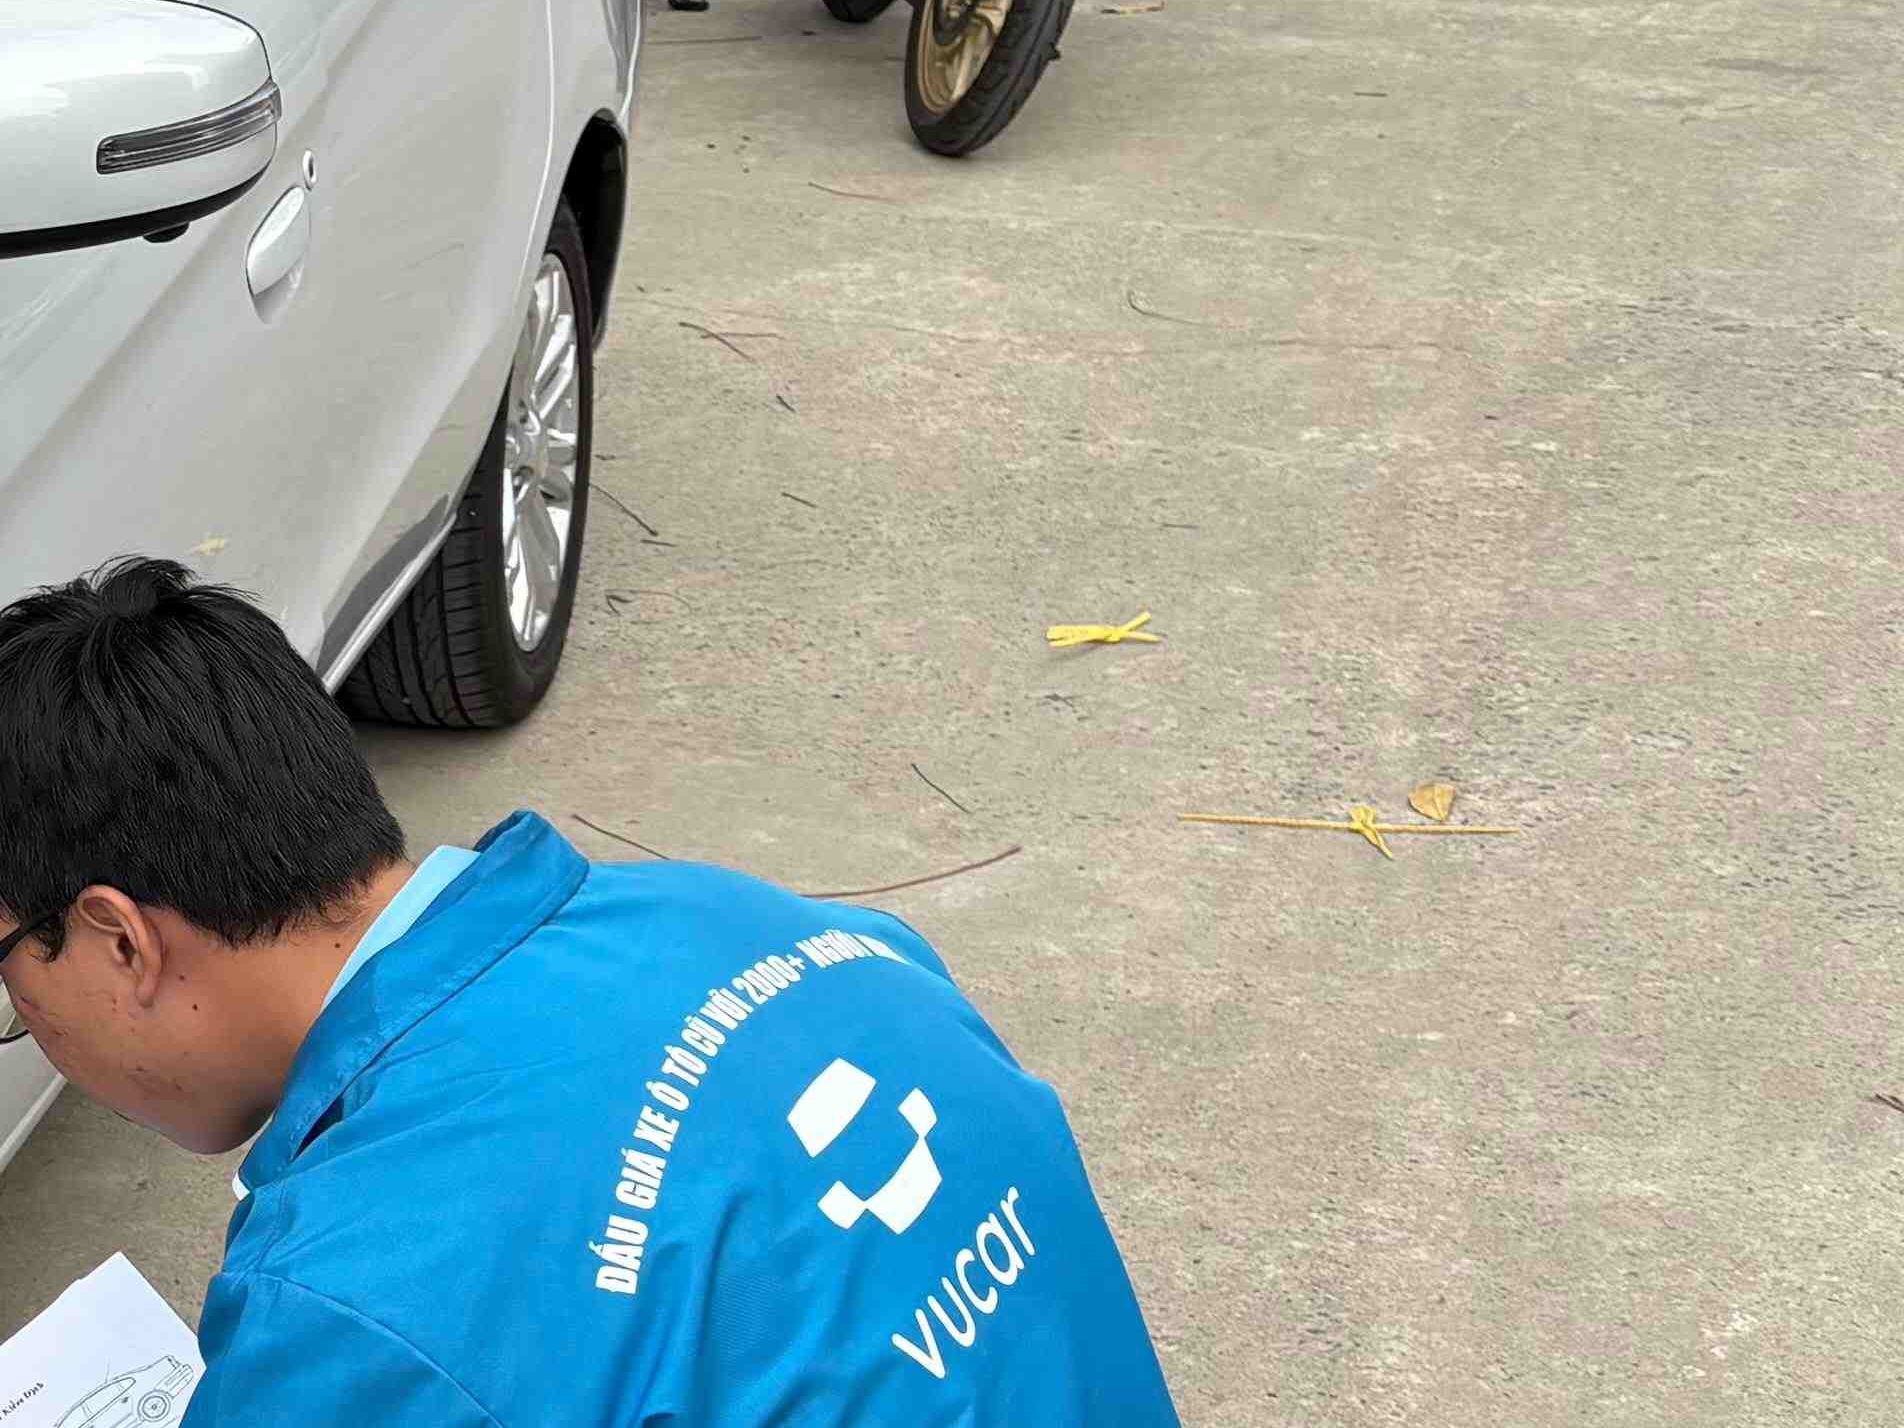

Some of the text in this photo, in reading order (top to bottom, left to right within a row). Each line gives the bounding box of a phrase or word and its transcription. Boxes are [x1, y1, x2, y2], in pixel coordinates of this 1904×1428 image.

[731, 954, 806, 1005] 2000+
[661, 1045, 708, 1087] TÔ
[645, 1081, 690, 1111] Ô
[633, 1105, 680, 1152] XE
[616, 1147, 667, 1210] GIÁ
[892, 1186, 1035, 1379] vucar
